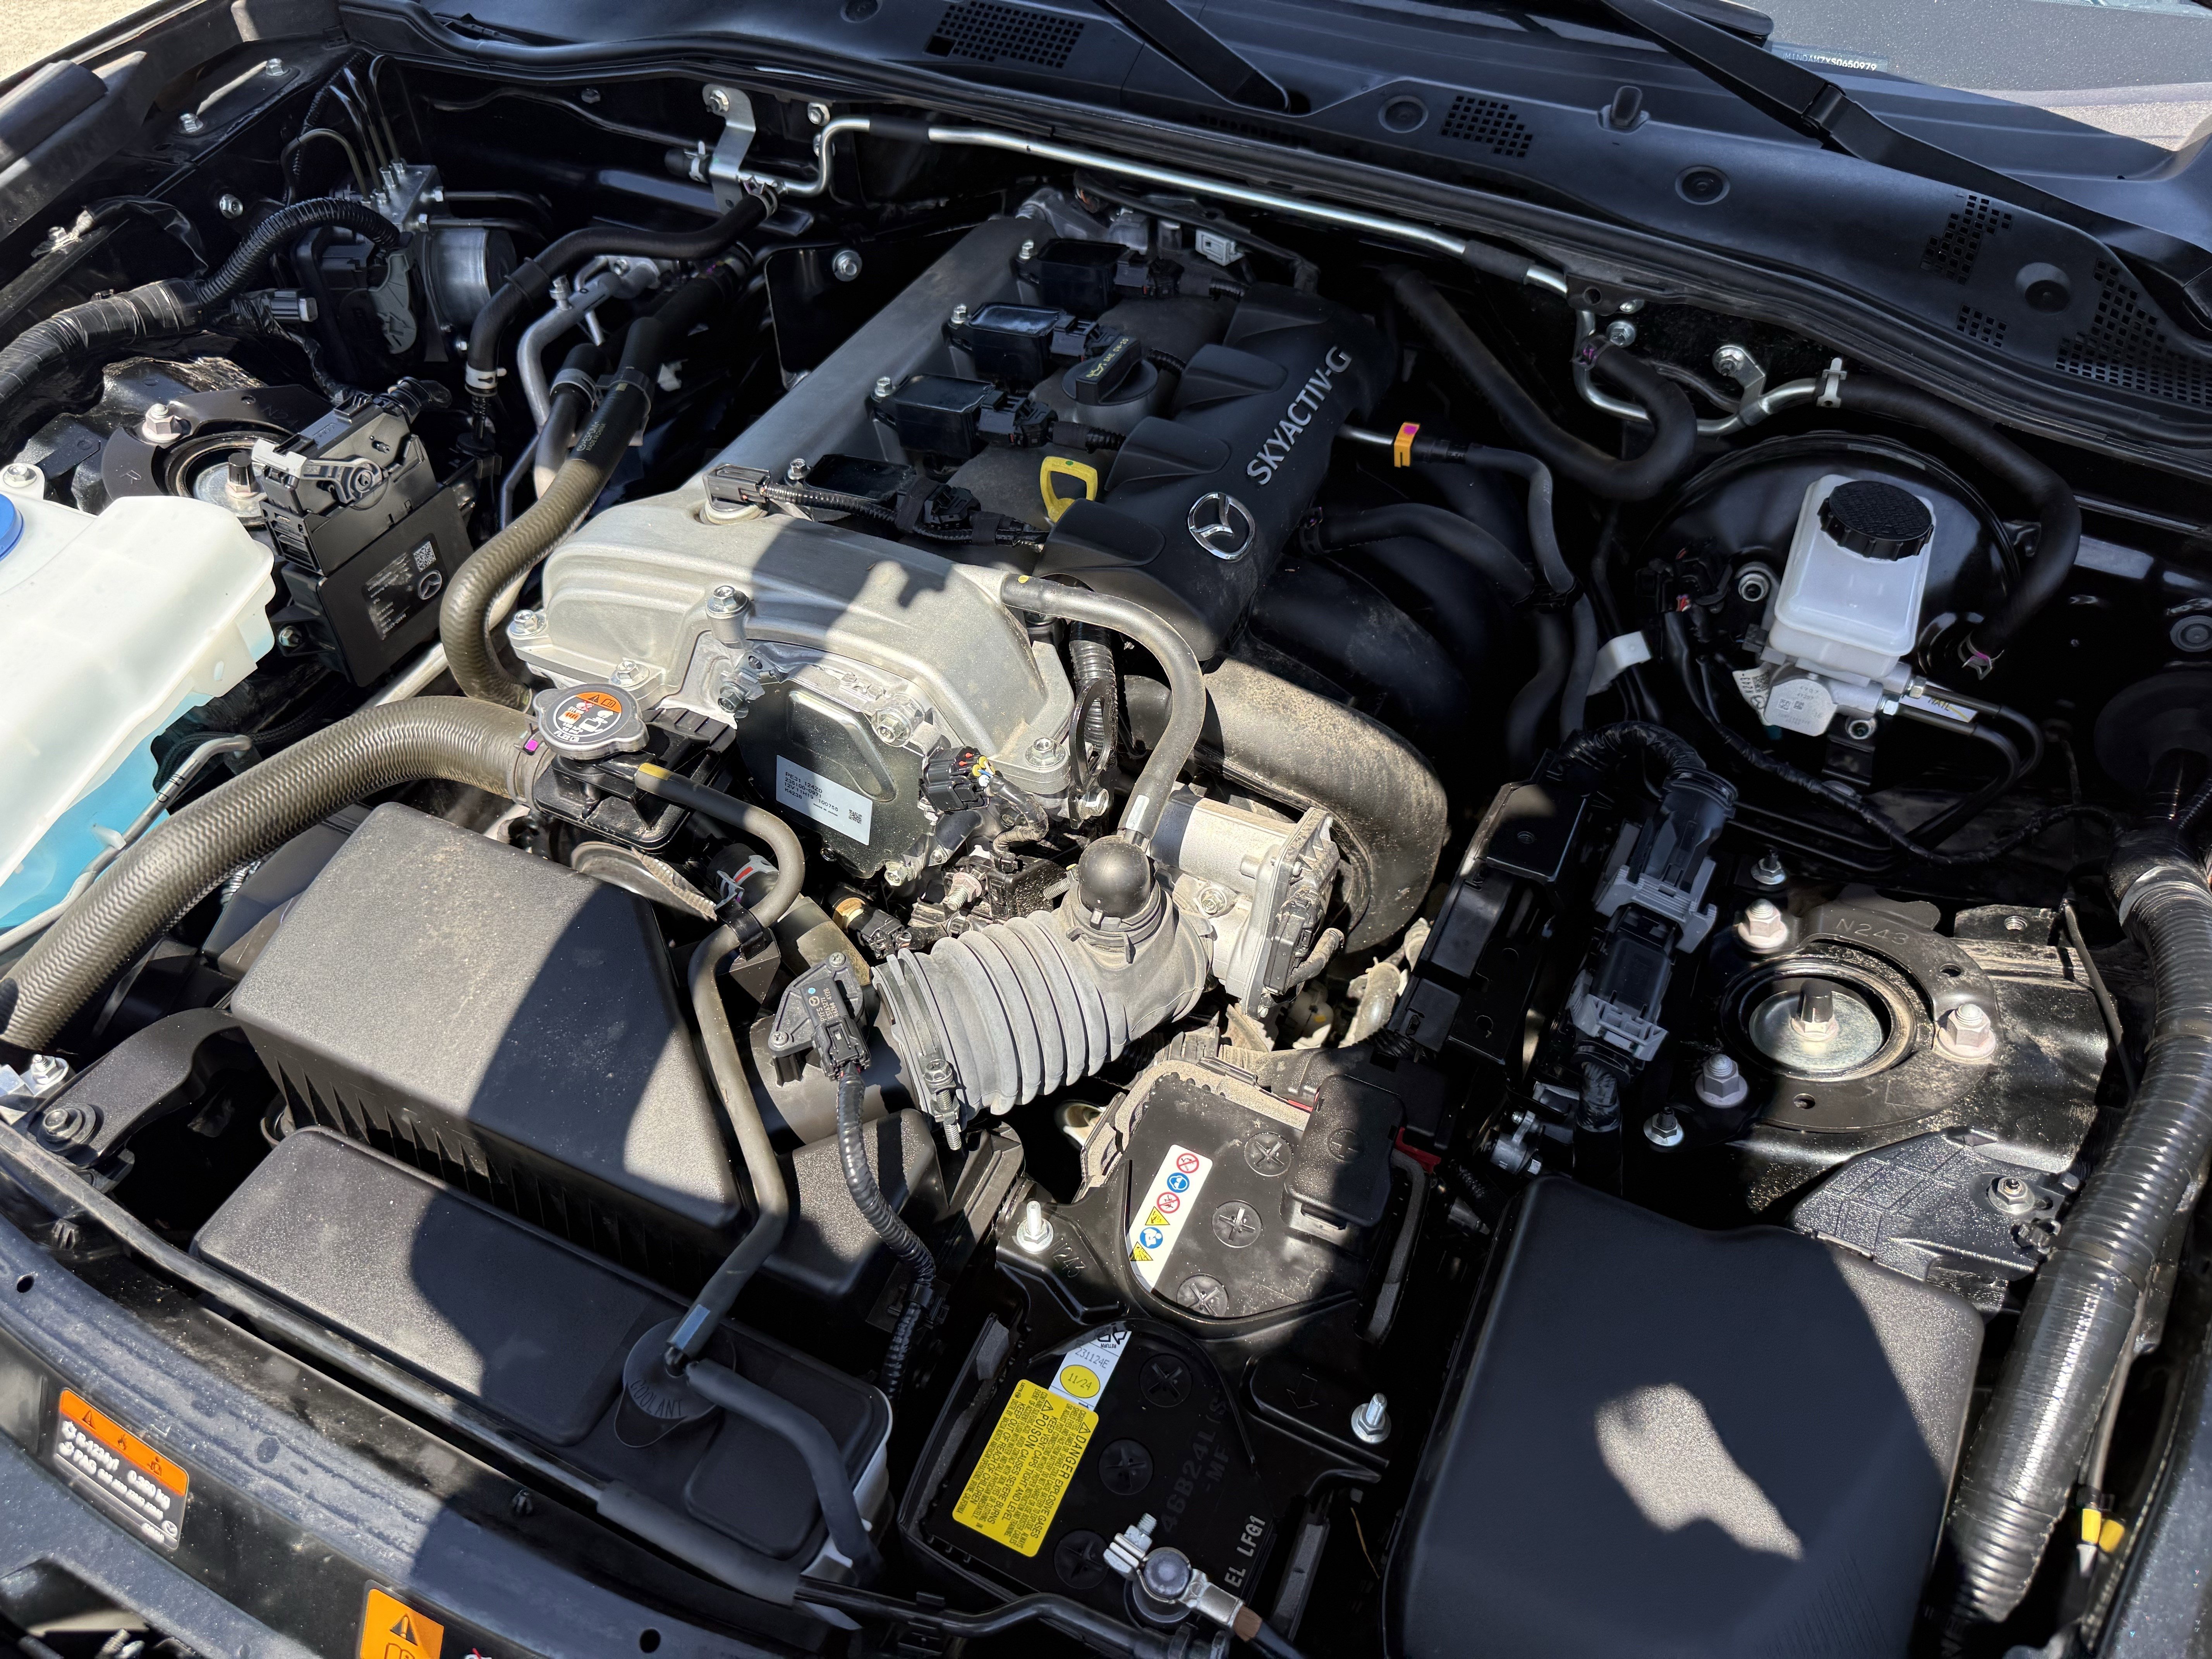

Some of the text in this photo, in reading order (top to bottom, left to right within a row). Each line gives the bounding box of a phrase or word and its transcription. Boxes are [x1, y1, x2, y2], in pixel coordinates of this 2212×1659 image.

[1247, 346, 1352, 485] SKYACTIV-G
[1836, 918, 1909, 945] N243
[1075, 1346, 1110, 1369] 231124E
[1067, 1373, 1092, 1391] 11/24
[630, 1379, 682, 1418] COOLANT
[1030, 1388, 1041, 1401] EVENT
[1034, 1391, 1048, 1410] CONTAINS
[1020, 1404, 1033, 1423] ACCIDENT
[1026, 1407, 1040, 1426] SULFURIC
[1058, 1408, 1070, 1423] ADJUST
[1068, 1406, 1080, 1420] SHIELD
[998, 1416, 1010, 1430] MAZDA
[1014, 1420, 1025, 1433] FLUSH
[1054, 1421, 1064, 1433] POST
[1064, 1418, 1074, 1429] EYES
[992, 1428, 1004, 1442] NORTH
[1009, 1431, 1020, 1443] WITH
[1056, 1434, 1066, 1446] FACE
[1060, 1427, 1070, 1437] AND
[1064, 1431, 1076, 1447] FLAMES
[983, 1439, 998, 1459] AMERICAN
[1003, 1441, 1015, 1456] WATER
[1015, 1435, 1026, 1448] AVOID
[1042, 1431, 1060, 1456] CONNECTIONS
[1051, 1443, 1062, 1456] FROM
[969, 1401, 1026, 1505] KEEP OUT OF REACH OF CHILDREN
[999, 1454, 1008, 1464] AND
[1007, 1446, 1020, 1465] CONTACT
[1054, 1452, 1066, 1468] SPARKS
[986, 1412, 1049, 1525] POISON CAUSES SEVERE BURNS
[994, 1462, 1005, 1473] CALL
[1001, 1415, 1058, 1523] KEEP VENT CAPS TIGHT AND LEVEL
[1001, 1463, 1012, 1475] WITH
[1035, 1455, 1048, 1473] WITHOUT
[1027, 1471, 1041, 1488] PROPER
[1037, 1476, 1046, 1486] NOT
[1048, 1466, 1060, 1481] COULD
[984, 1474, 998, 1495] PHYSICIAN
[991, 1485, 1001, 1496] EYES
[1029, 1434, 1087, 1539] DANGER EXPLOSIVE GASES
[1030, 1484, 1043, 1501] CHARGE
[1042, 1479, 1054, 1492] CAUSE
[955, 1492, 972, 1515] CALIFORNIA
[988, 1495, 997, 1503] OR
[1017, 1486, 1034, 1511] INSTRUCTION
[1035, 1491, 1048, 1508] BATTERY
[1012, 1509, 1022, 1520] AND
[1024, 1504, 1033, 1514] USE
[1015, 1512, 1029, 1531] BOOSTER
[1009, 1529, 1021, 1545] CABLES
[1015, 1531, 1029, 1549] ALWAYS
[1224, 1515, 1266, 1587] EL LFG1
